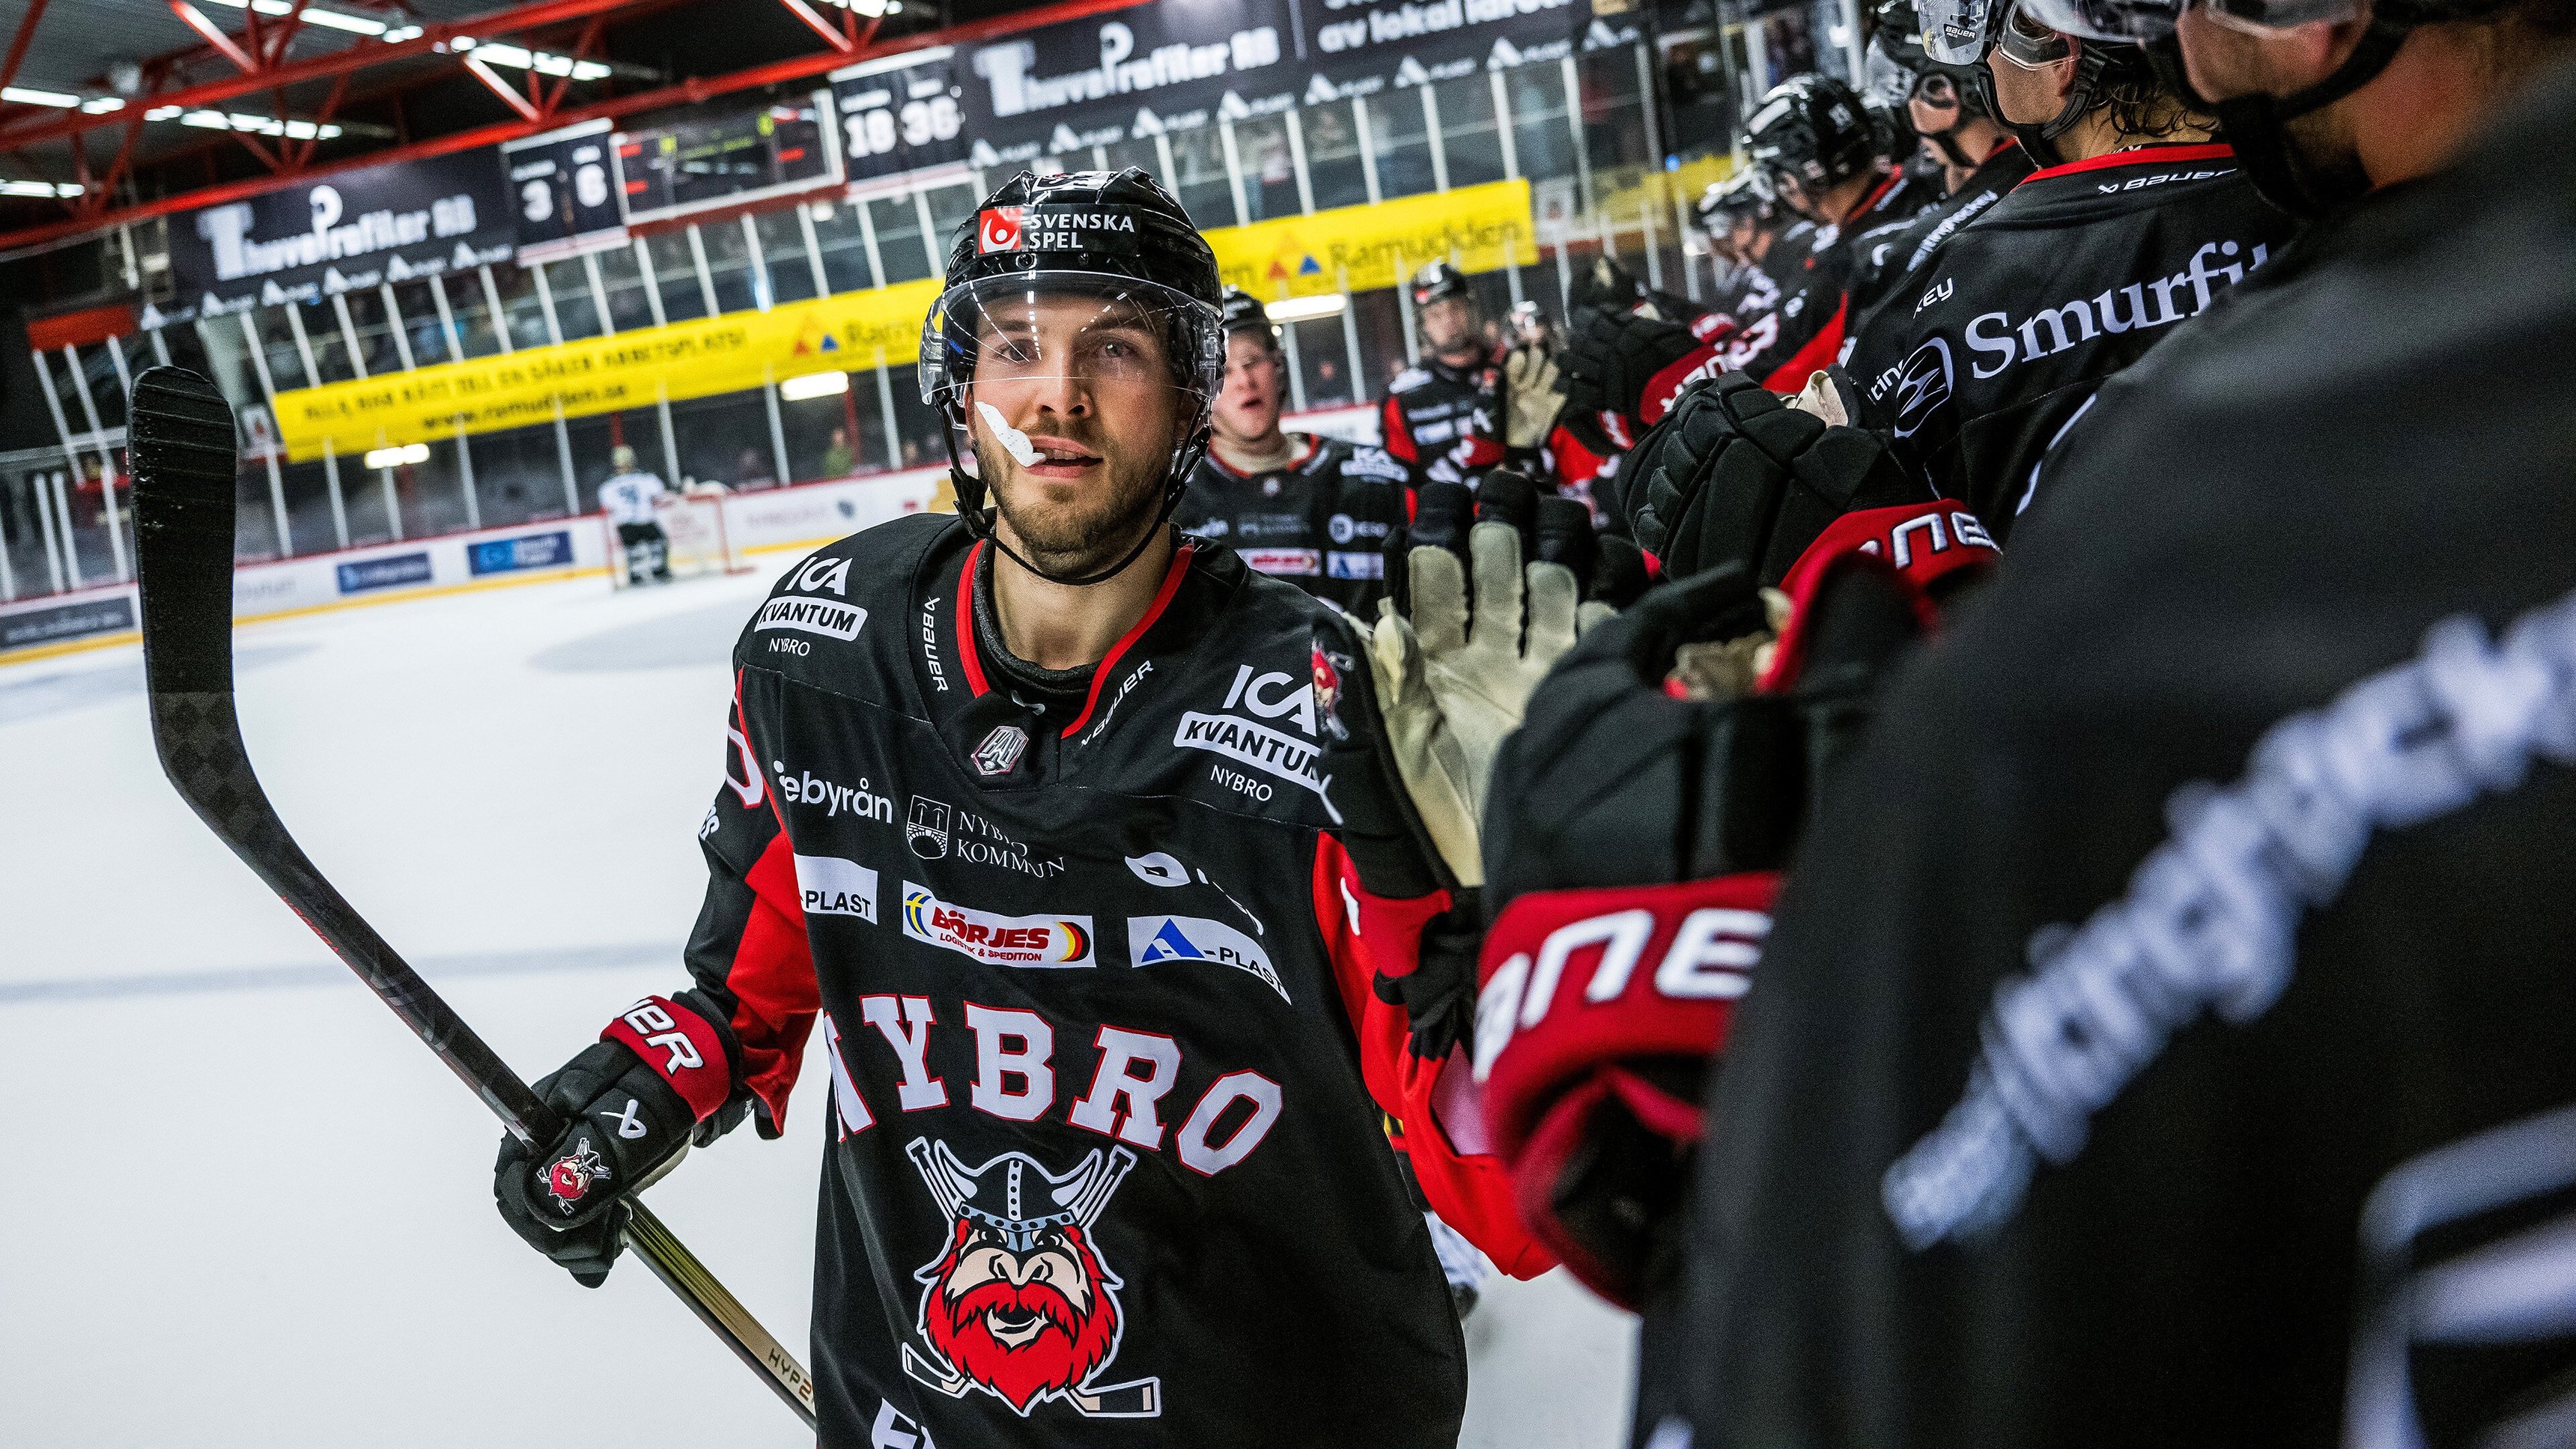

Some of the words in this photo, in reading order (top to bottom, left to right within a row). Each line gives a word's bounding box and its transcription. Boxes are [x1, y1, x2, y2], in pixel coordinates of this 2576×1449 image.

[1945, 25, 1975, 39] BAUER
[521, 178, 554, 222] 3
[1029, 231, 1084, 249] SPEL
[1030, 213, 1135, 233] SVENSKA
[785, 556, 853, 596] ICA
[759, 601, 858, 633] KVANTUM
[768, 637, 811, 657] NYBRO
[923, 613, 949, 692] BAUER
[1091, 660, 1155, 740] BAUER
[1222, 664, 1317, 737] ICA
[1210, 765, 1272, 802] NYBRO
[957, 838, 1065, 878] KOMMUN
[801, 890, 871, 917] PLAST
[931, 906, 1051, 950] BÖRJES
[940, 932, 976, 955] LOGISTIK
[978, 947, 985, 957] &
[988, 950, 1042, 962] SPEDITION
[768, 1348, 812, 1402] HYP2
